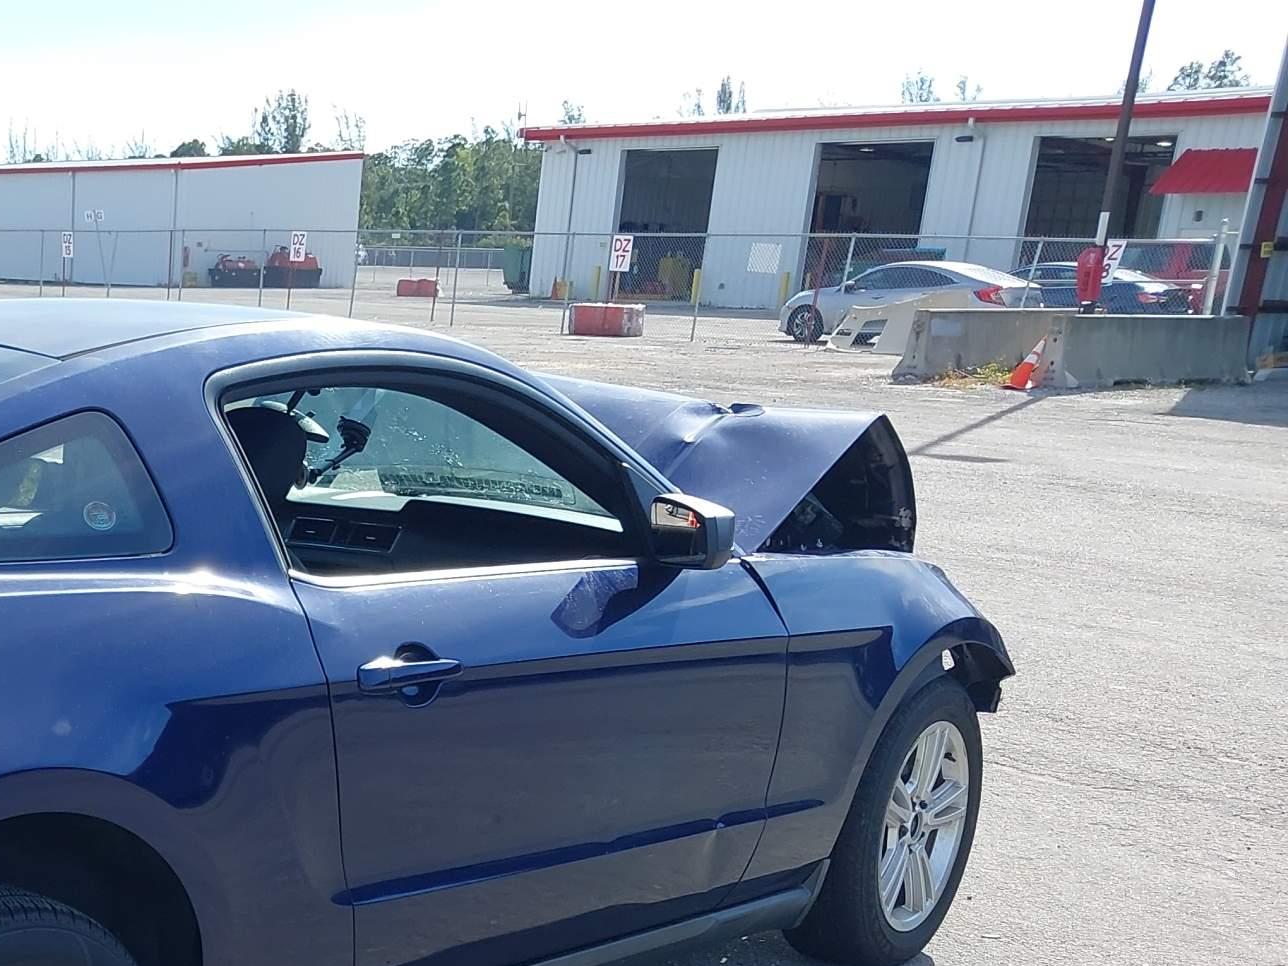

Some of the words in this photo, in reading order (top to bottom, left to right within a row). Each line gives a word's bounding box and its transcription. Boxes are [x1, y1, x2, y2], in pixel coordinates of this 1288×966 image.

[63, 233, 73, 245] DZ
[292, 233, 306, 246] DZ
[614, 238, 632, 253] DZ
[293, 247, 302, 259] 16
[615, 255, 626, 269] 17
